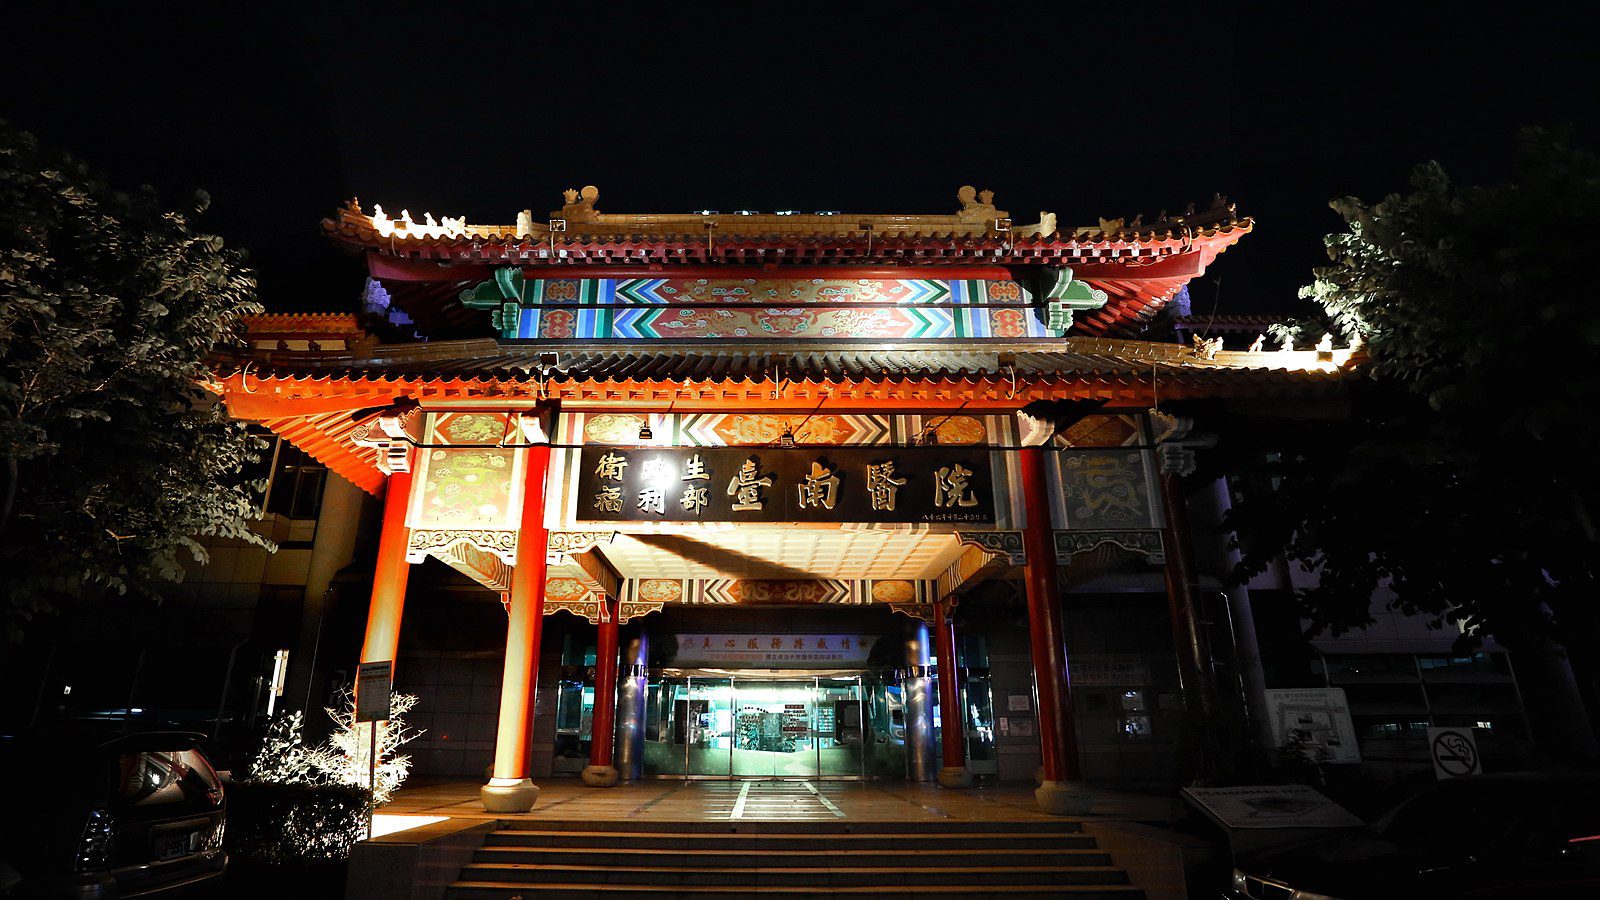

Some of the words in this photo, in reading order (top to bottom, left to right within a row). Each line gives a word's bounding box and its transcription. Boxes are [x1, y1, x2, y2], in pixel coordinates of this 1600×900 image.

[593, 484, 710, 515] 福利部
[726, 459, 979, 511] 臺南醫院
